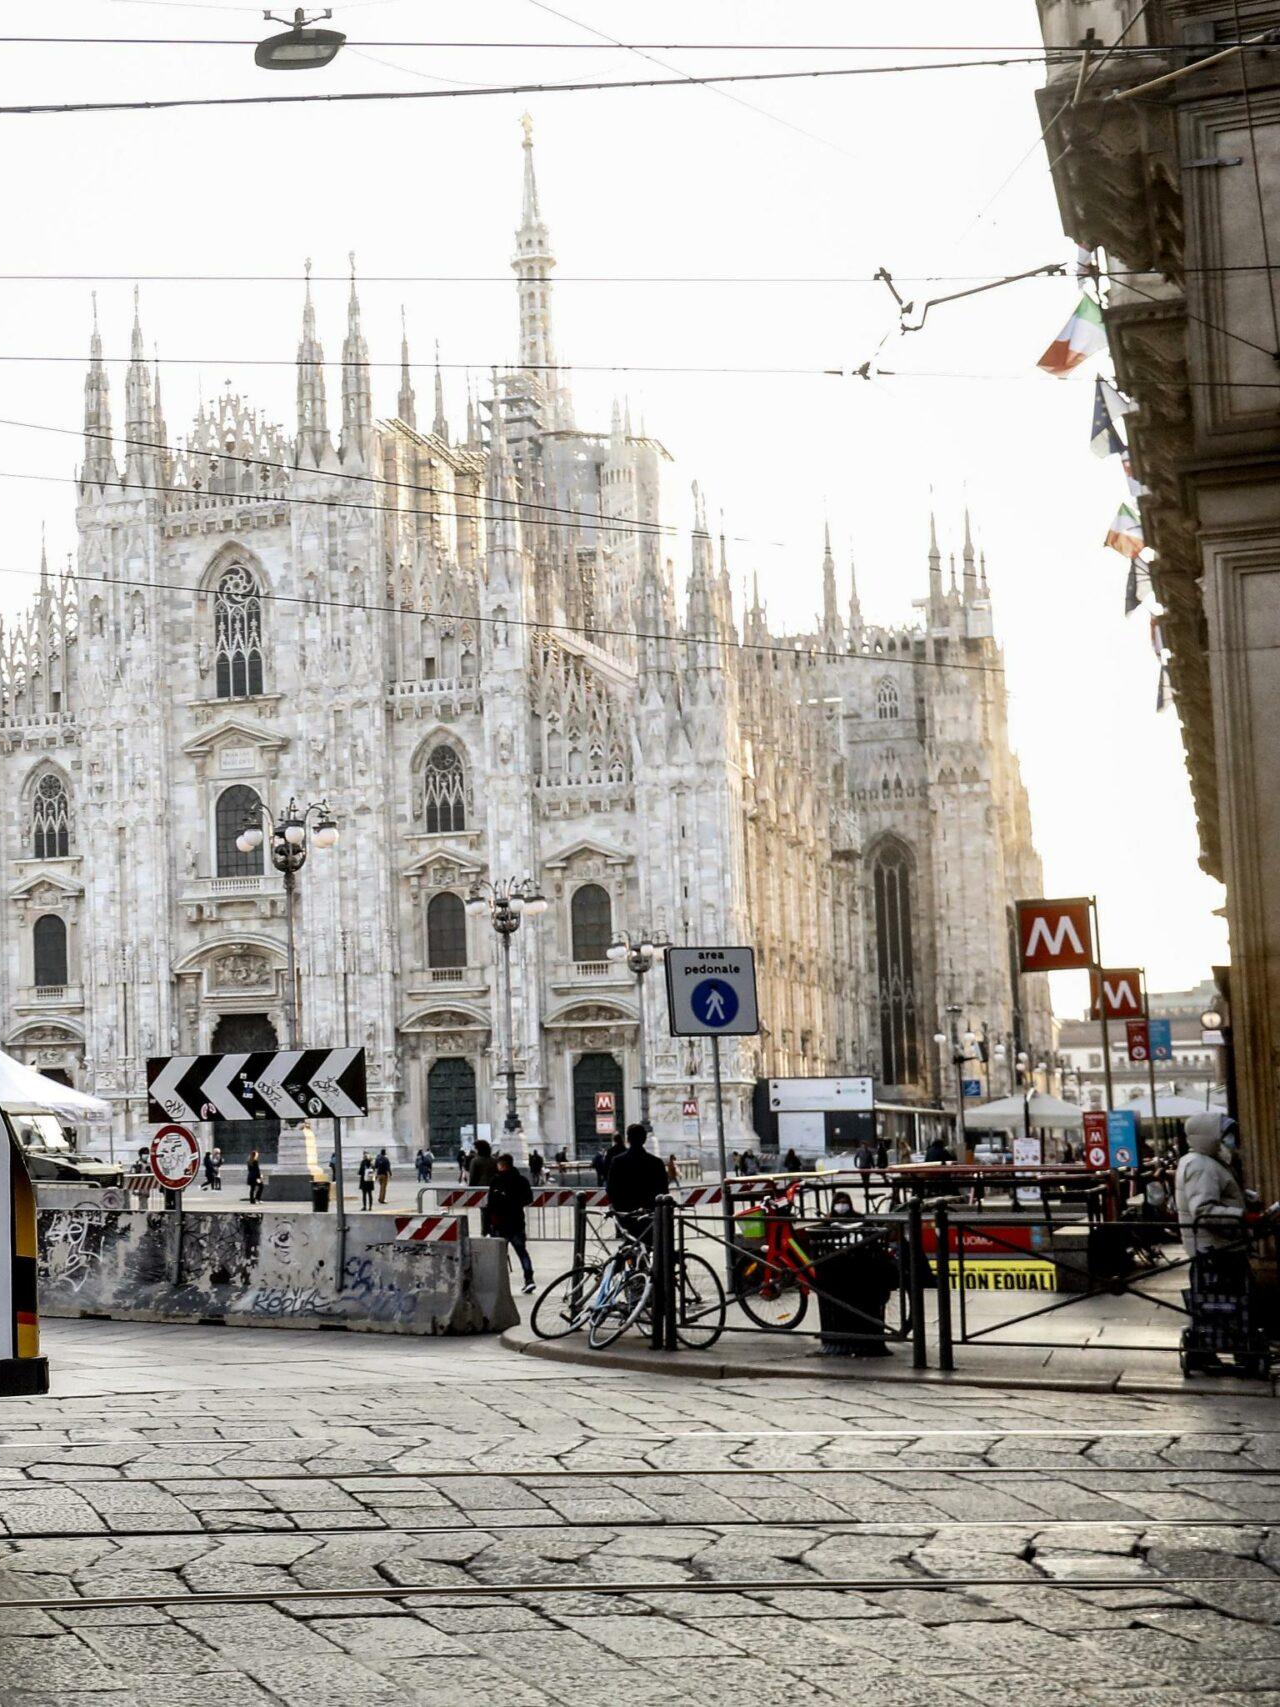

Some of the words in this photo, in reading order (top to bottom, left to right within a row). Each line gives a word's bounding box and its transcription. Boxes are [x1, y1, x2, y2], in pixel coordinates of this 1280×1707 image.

[1024, 915, 1085, 957] M
[697, 951, 725, 960] area
[684, 963, 741, 976] pedonale
[1094, 980, 1137, 1010] M
[596, 1096, 611, 1108] M
[684, 1103, 697, 1113] M
[1090, 1131, 1103, 1142] M
